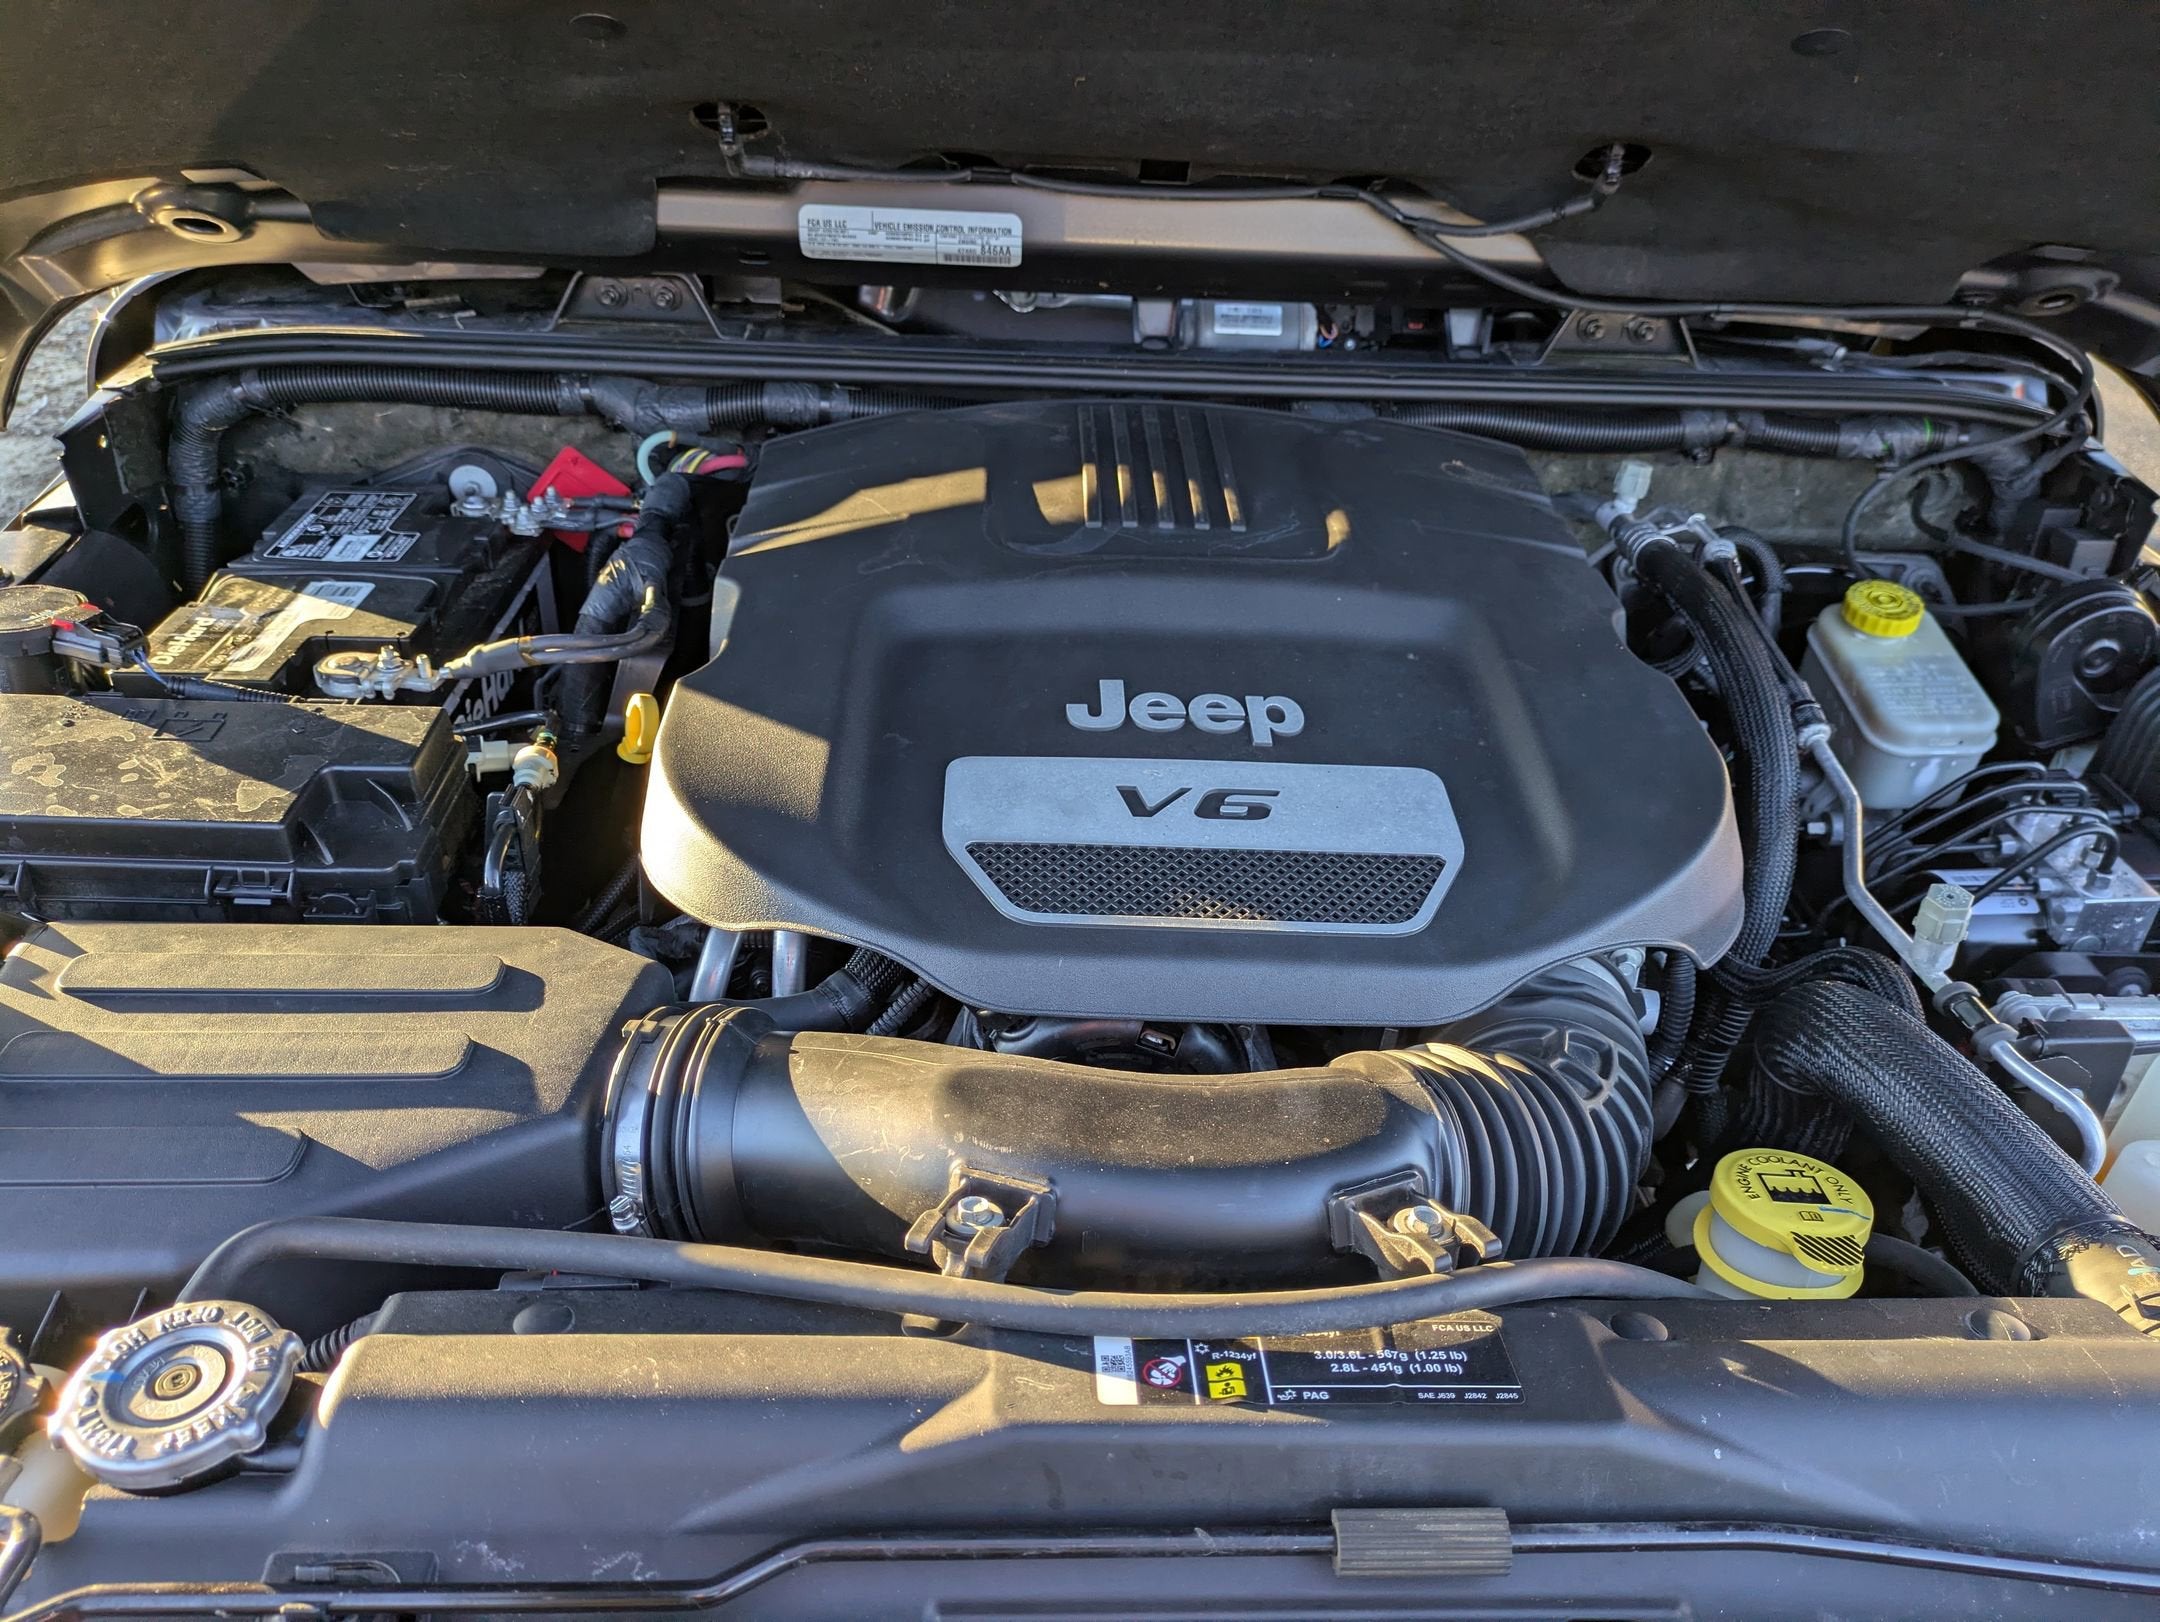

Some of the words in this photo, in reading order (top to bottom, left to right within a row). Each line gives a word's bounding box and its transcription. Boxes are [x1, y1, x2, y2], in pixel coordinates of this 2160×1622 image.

[807, 218, 821, 228] FCA
[822, 219, 832, 228] US
[833, 219, 848, 229] LLC
[874, 221, 901, 231] VEHICLE
[903, 222, 935, 233] EMISSION
[935, 224, 966, 234] CONTROL
[967, 225, 1012, 236] INFORMATION
[149, 616, 217, 666] DieHard
[1065, 679, 1306, 747] Jeep
[1115, 784, 1281, 821] V6
[1748, 1155, 1825, 1175] COOLANT
[1736, 1163, 1761, 1200] ENGINE
[1826, 1176, 1853, 1205] ONLY
[155, 1305, 225, 1333] OPEN
[1431, 1324, 1453, 1332] FCA
[1472, 1325, 1494, 1333] LLC
[224, 1310, 273, 1350] NOT
[1211, 1350, 1257, 1362] R-1234yf
[1313, 1350, 1365, 1360] 3.0/3.6L
[1376, 1349, 1408, 1362] 567g
[1414, 1350, 1446, 1362] (1.25
[1449, 1350, 1468, 1362] lb)
[1330, 1363, 1360, 1372] 2.8L
[1371, 1362, 1402, 1374] 451g
[1409, 1362, 1441, 1374] (1.00
[1444, 1362, 1463, 1374] lb)
[1302, 1391, 1330, 1400] PAG
